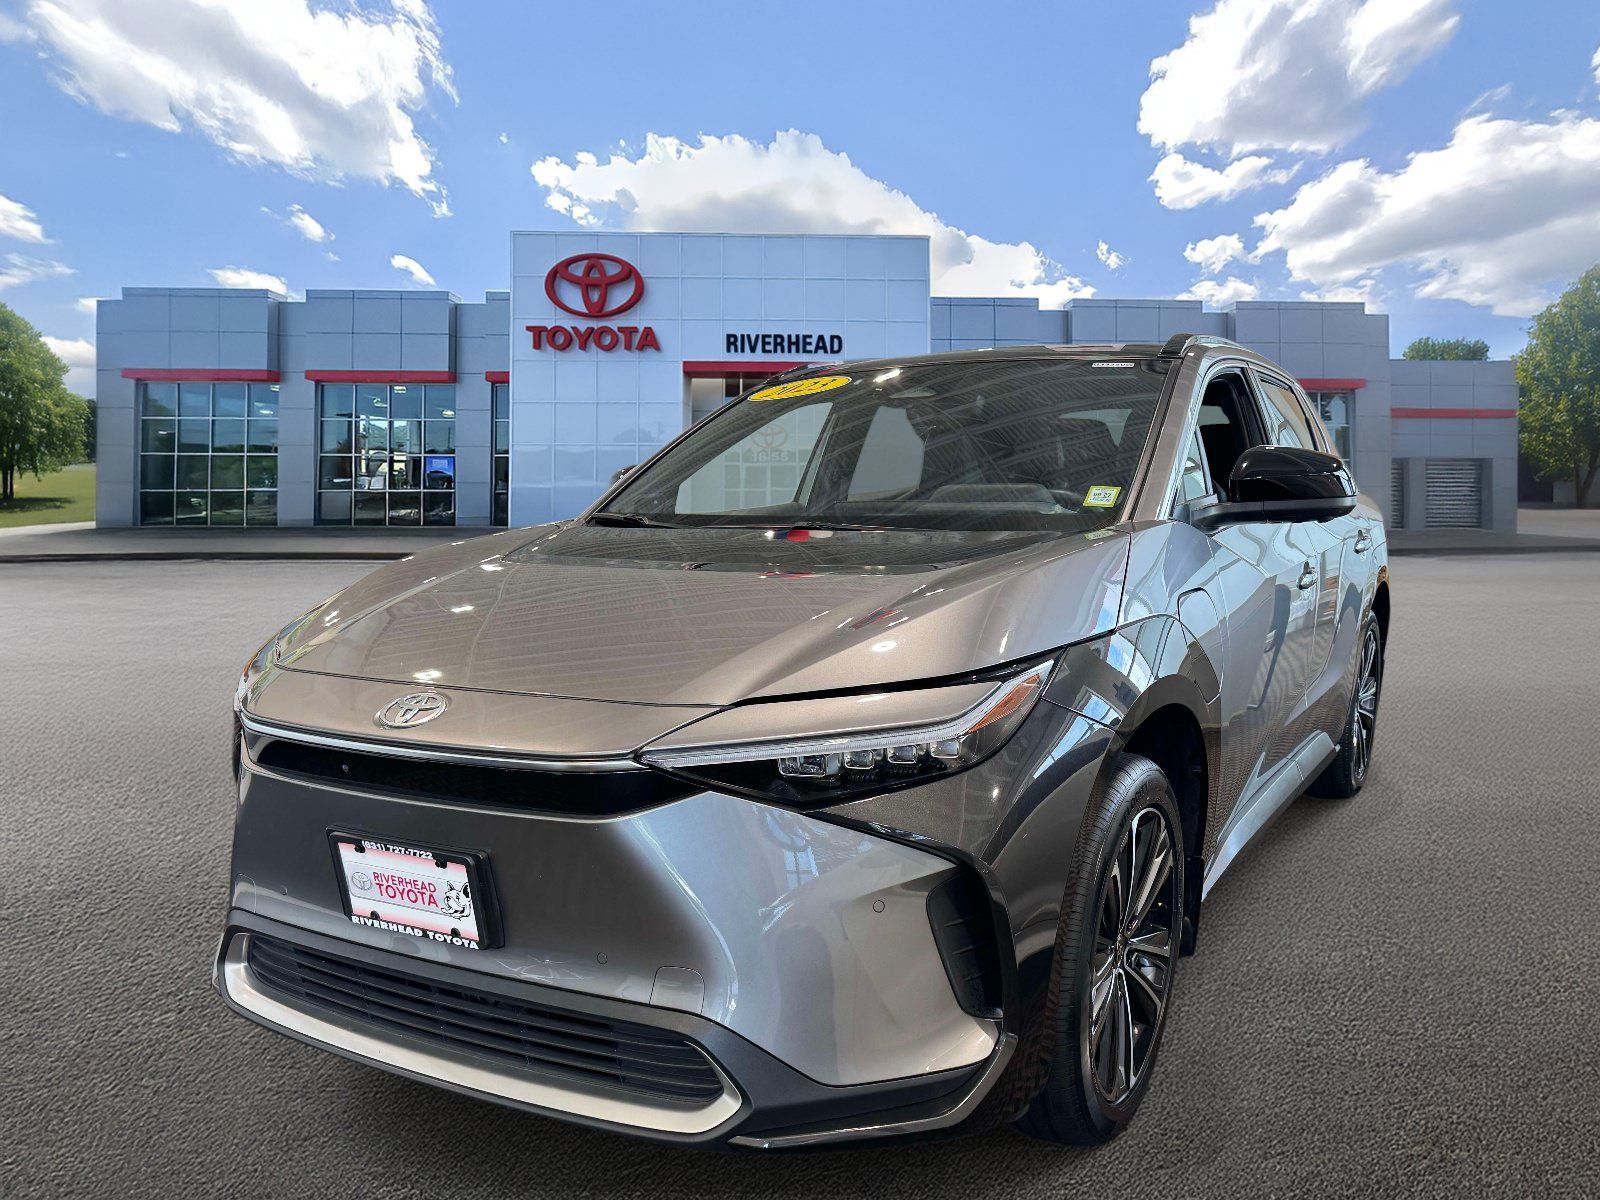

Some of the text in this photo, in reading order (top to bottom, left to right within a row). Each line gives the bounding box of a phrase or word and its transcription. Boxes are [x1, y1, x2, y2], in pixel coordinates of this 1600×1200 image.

[526, 326, 660, 351] TOYOTA
[725, 333, 843, 354] RIVERHEAD
[362, 840, 433, 859] (831) 727-7722
[373, 872, 437, 893] RIVERHEAD
[375, 883, 438, 907] TOYOTA
[351, 916, 479, 949] RIVERHEAD TOYOTA
